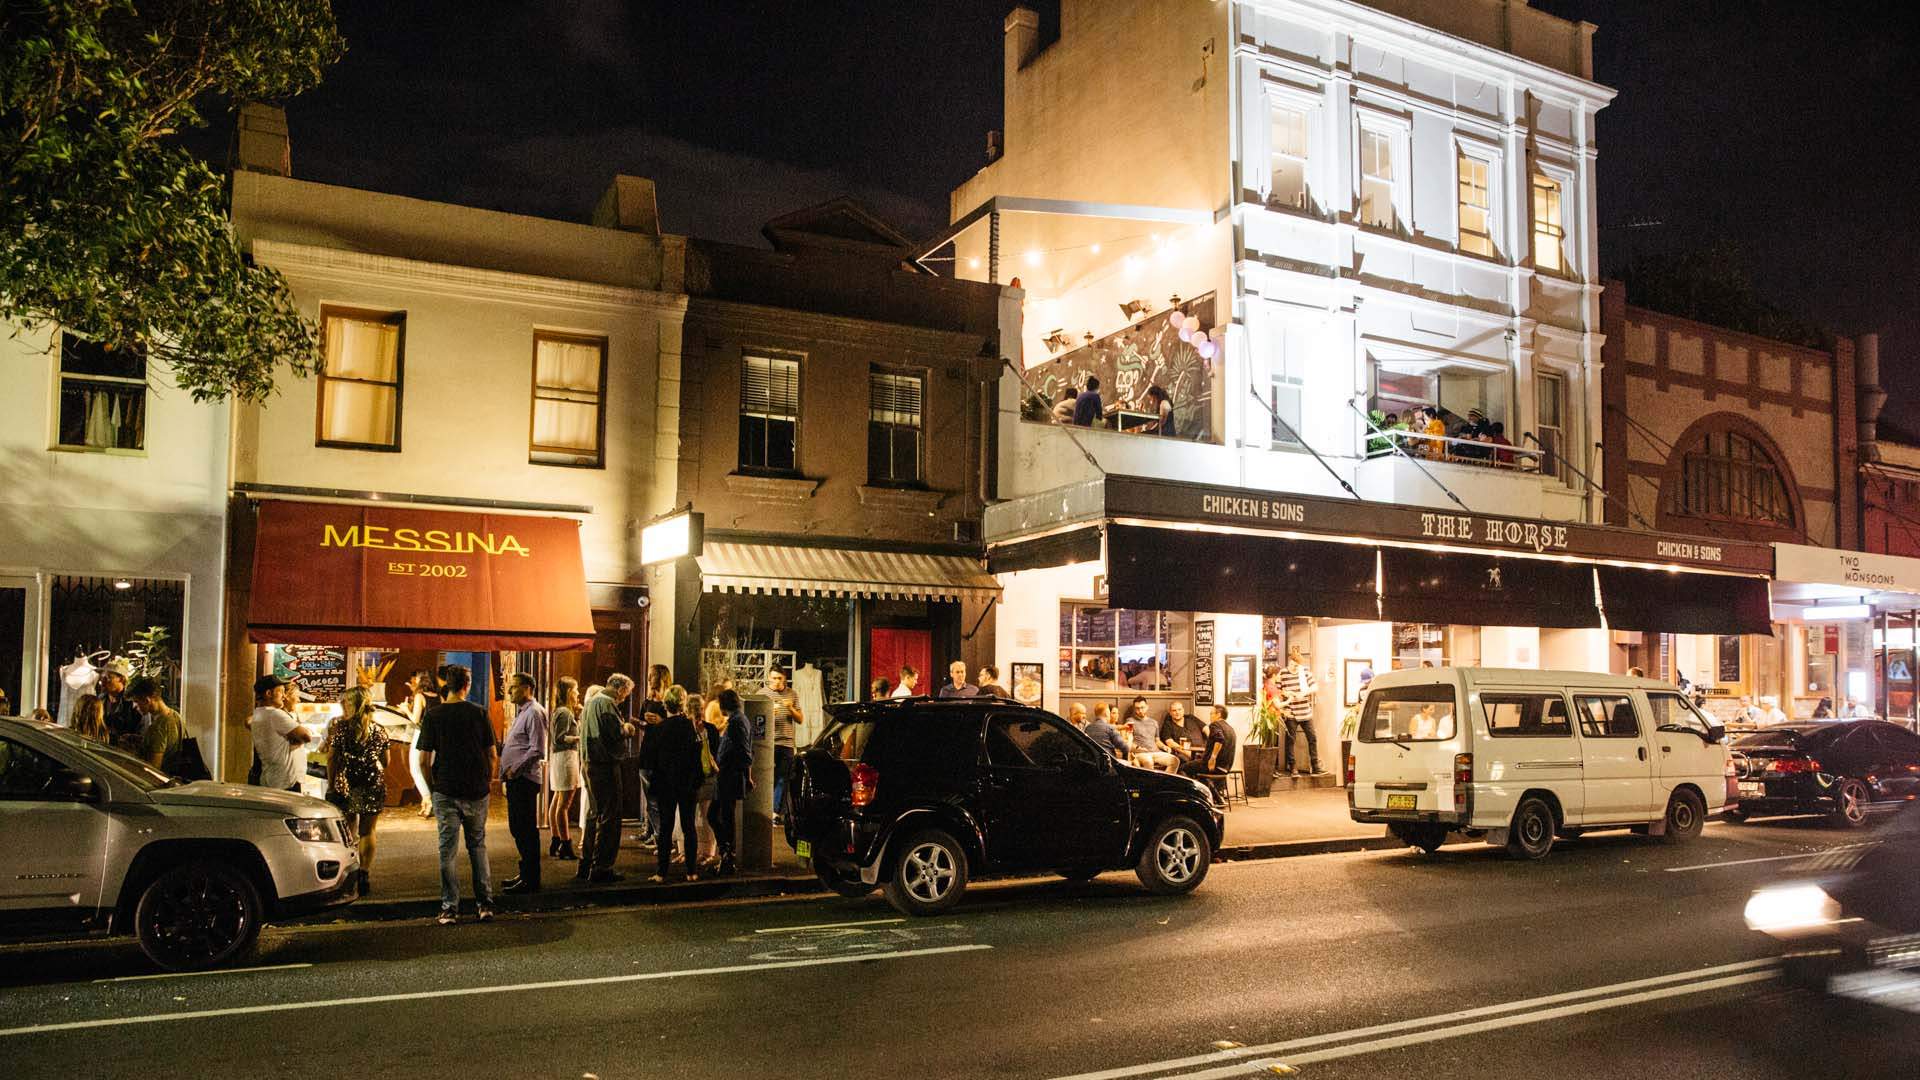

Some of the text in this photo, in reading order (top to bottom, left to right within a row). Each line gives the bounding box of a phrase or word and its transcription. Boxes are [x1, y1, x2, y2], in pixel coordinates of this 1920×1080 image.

[1203, 494, 1258, 517] CHICKEN
[1272, 502, 1304, 521] SONS
[320, 524, 530, 557] MESSINA
[1421, 513, 1568, 552] THE HORSE
[1657, 541, 1692, 559] CHICKEN
[1700, 545, 1721, 561] SONS
[388, 562, 468, 578] EST 2002
[1840, 556, 1859, 567] TWO
[1845, 572, 1895, 585] MONSOONS
